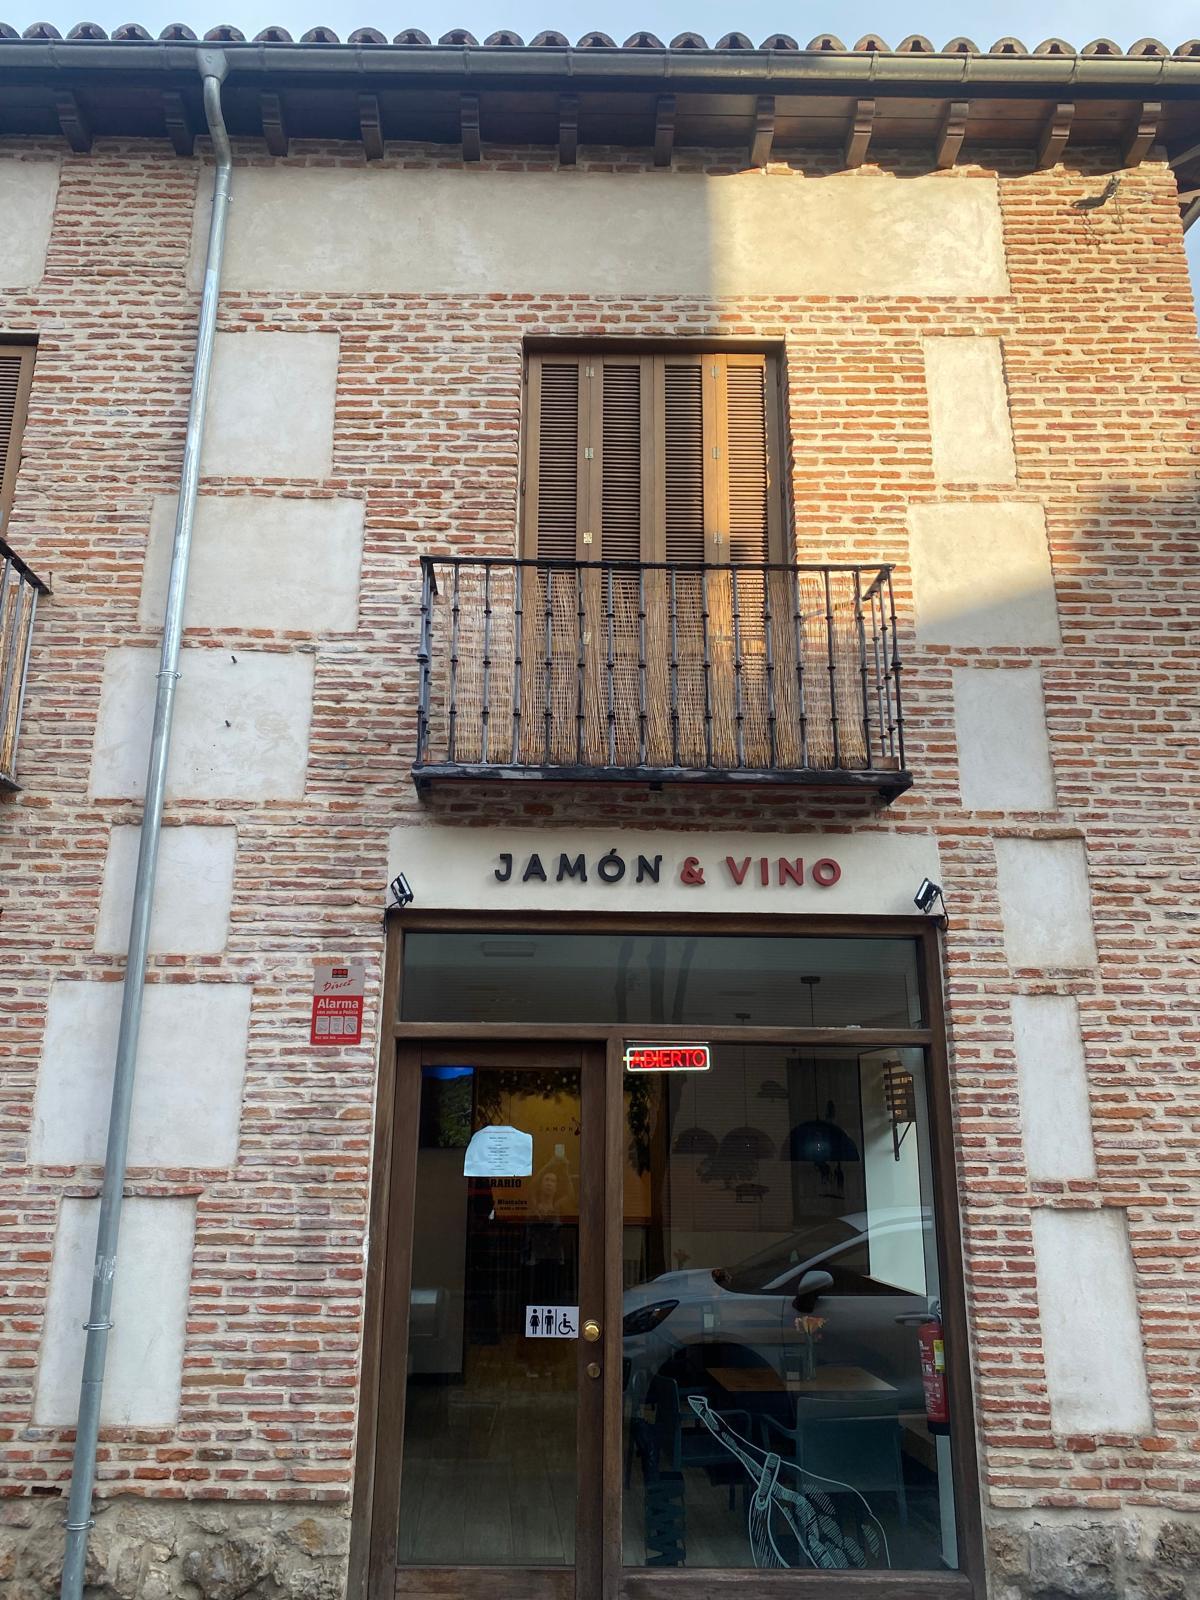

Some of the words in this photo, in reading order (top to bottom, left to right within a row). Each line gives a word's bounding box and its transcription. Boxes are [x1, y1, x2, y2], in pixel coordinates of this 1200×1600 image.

[494, 848, 663, 883] JAMÓN
[680, 856, 706, 885] &
[725, 856, 842, 887] VINO
[317, 998, 359, 1009] Alarma
[630, 1049, 706, 1068] ABIERTO
